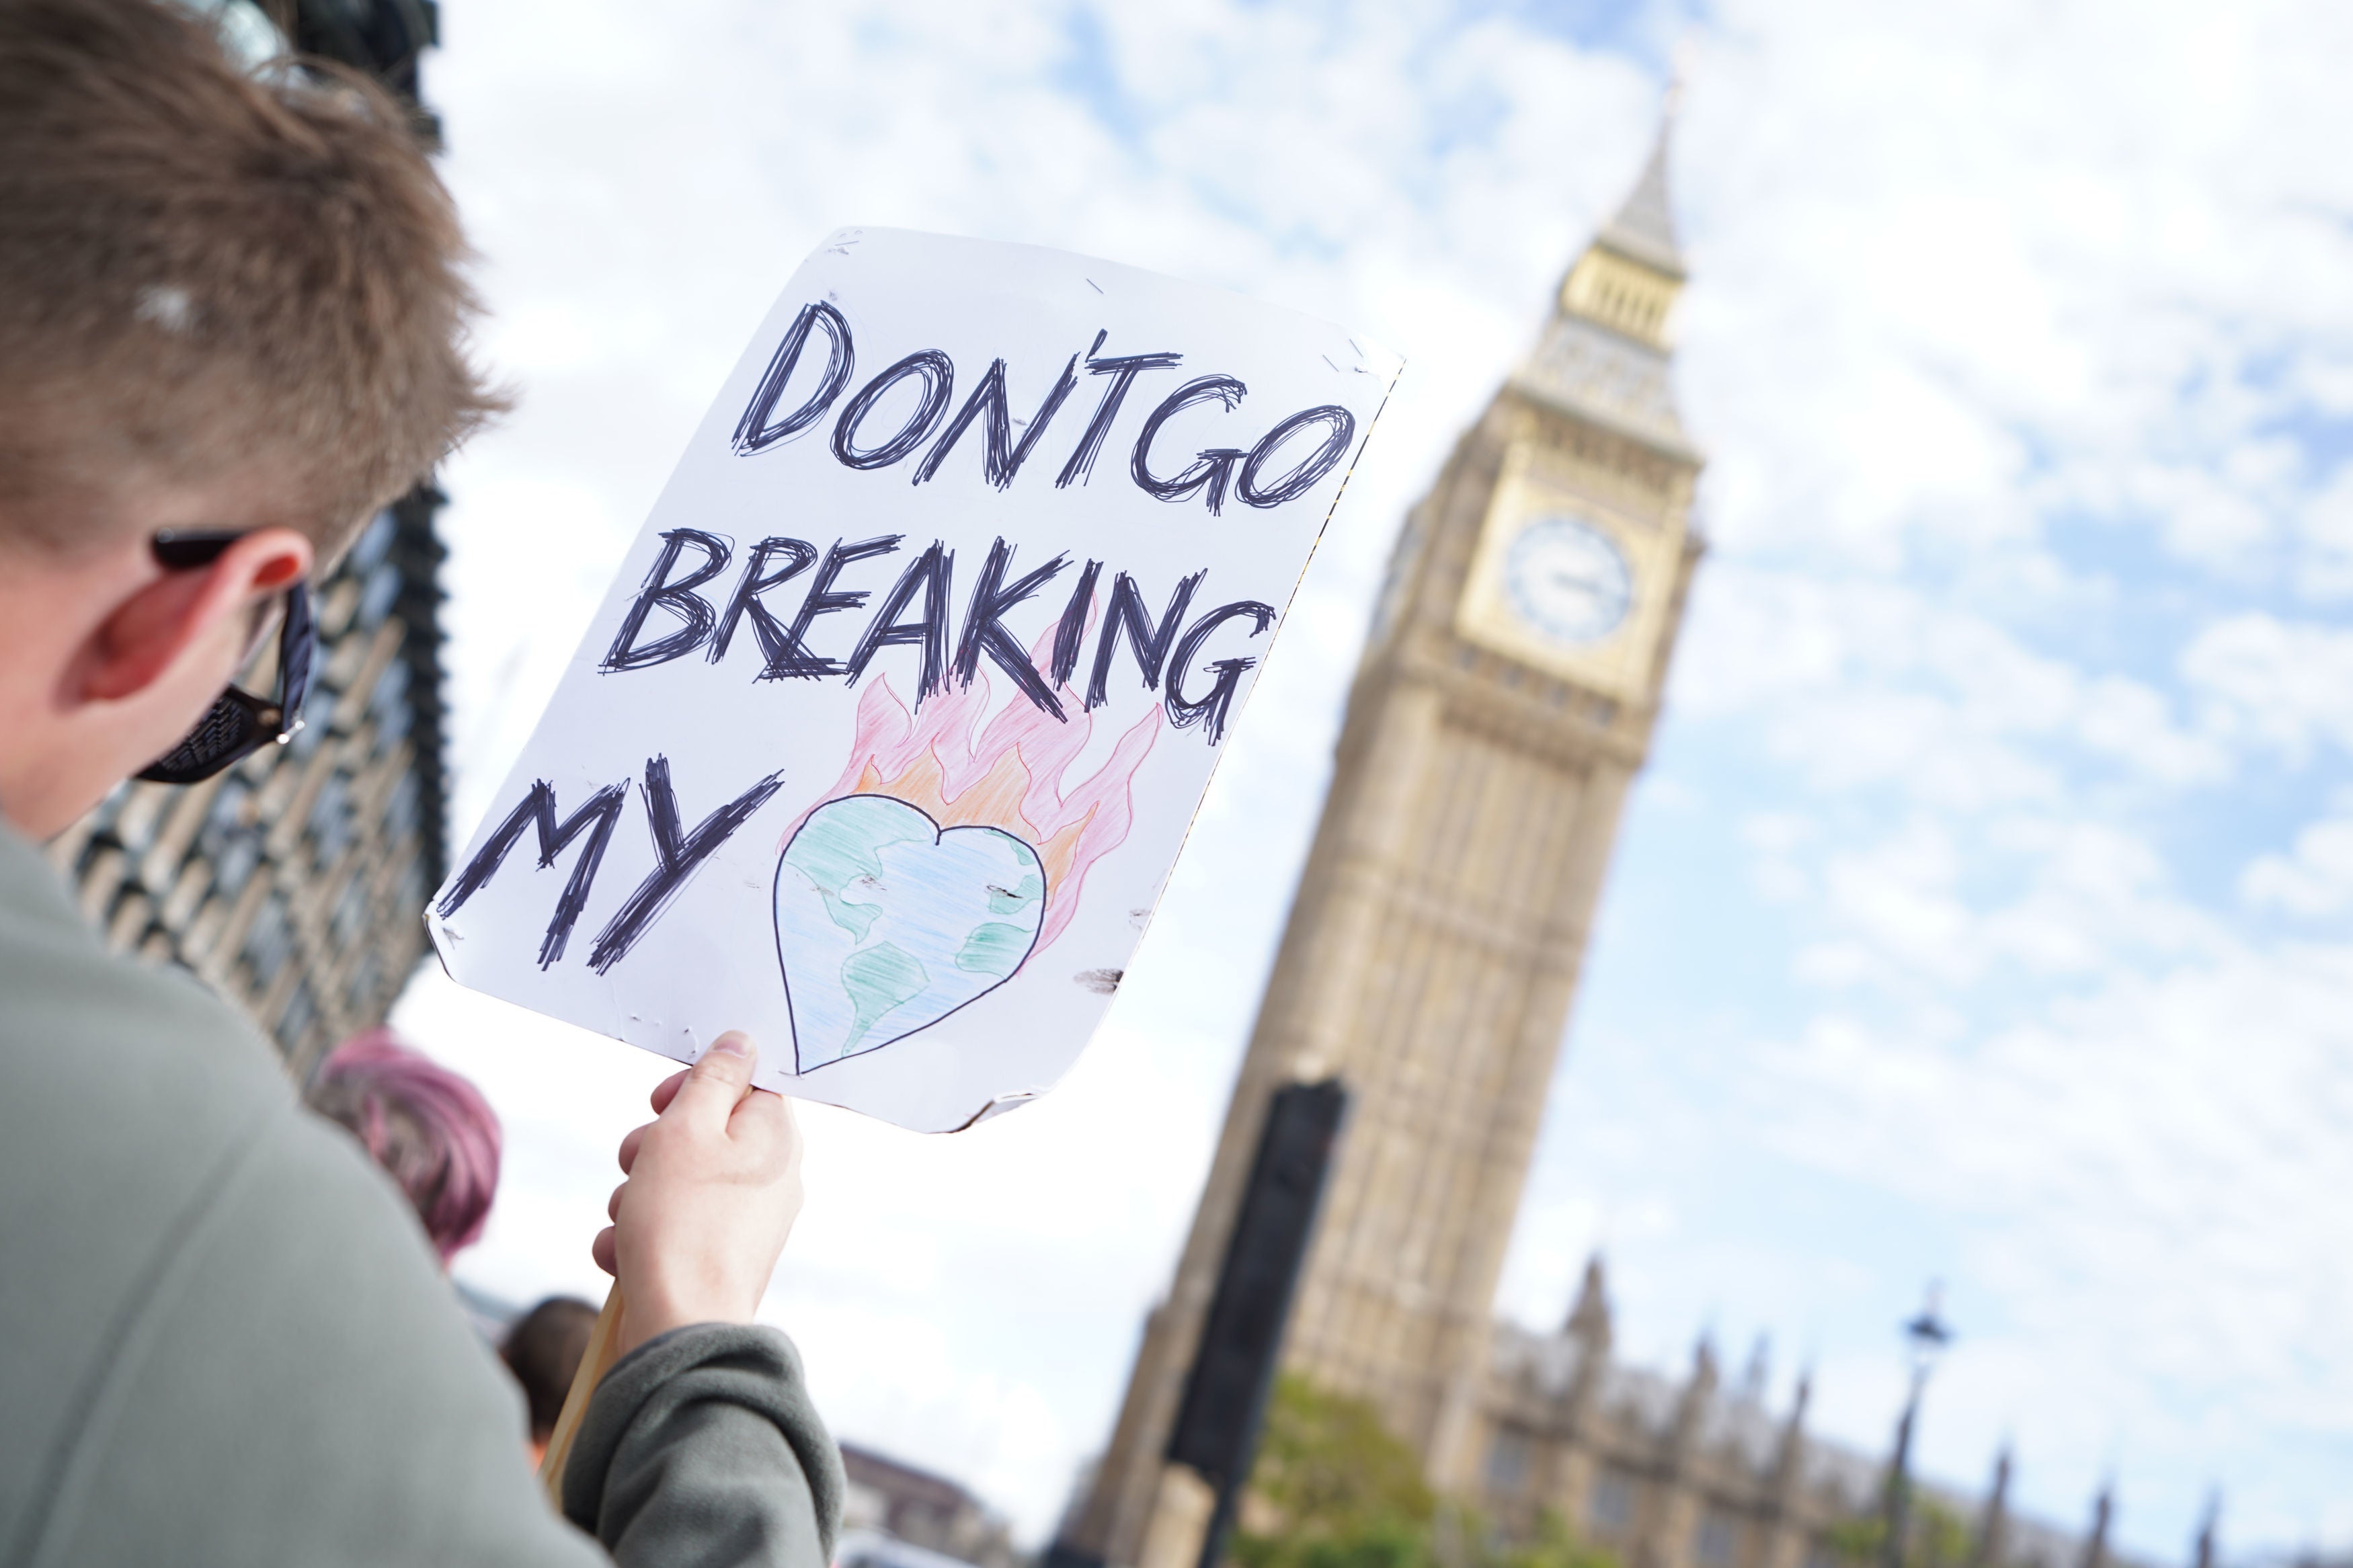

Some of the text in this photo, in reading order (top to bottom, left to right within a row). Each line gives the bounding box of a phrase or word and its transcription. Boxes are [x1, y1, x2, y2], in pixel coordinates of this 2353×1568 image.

[732, 300, 1355, 516] DON'T GO
[598, 528, 1277, 747] BREAKING
[436, 753, 785, 977] MY
